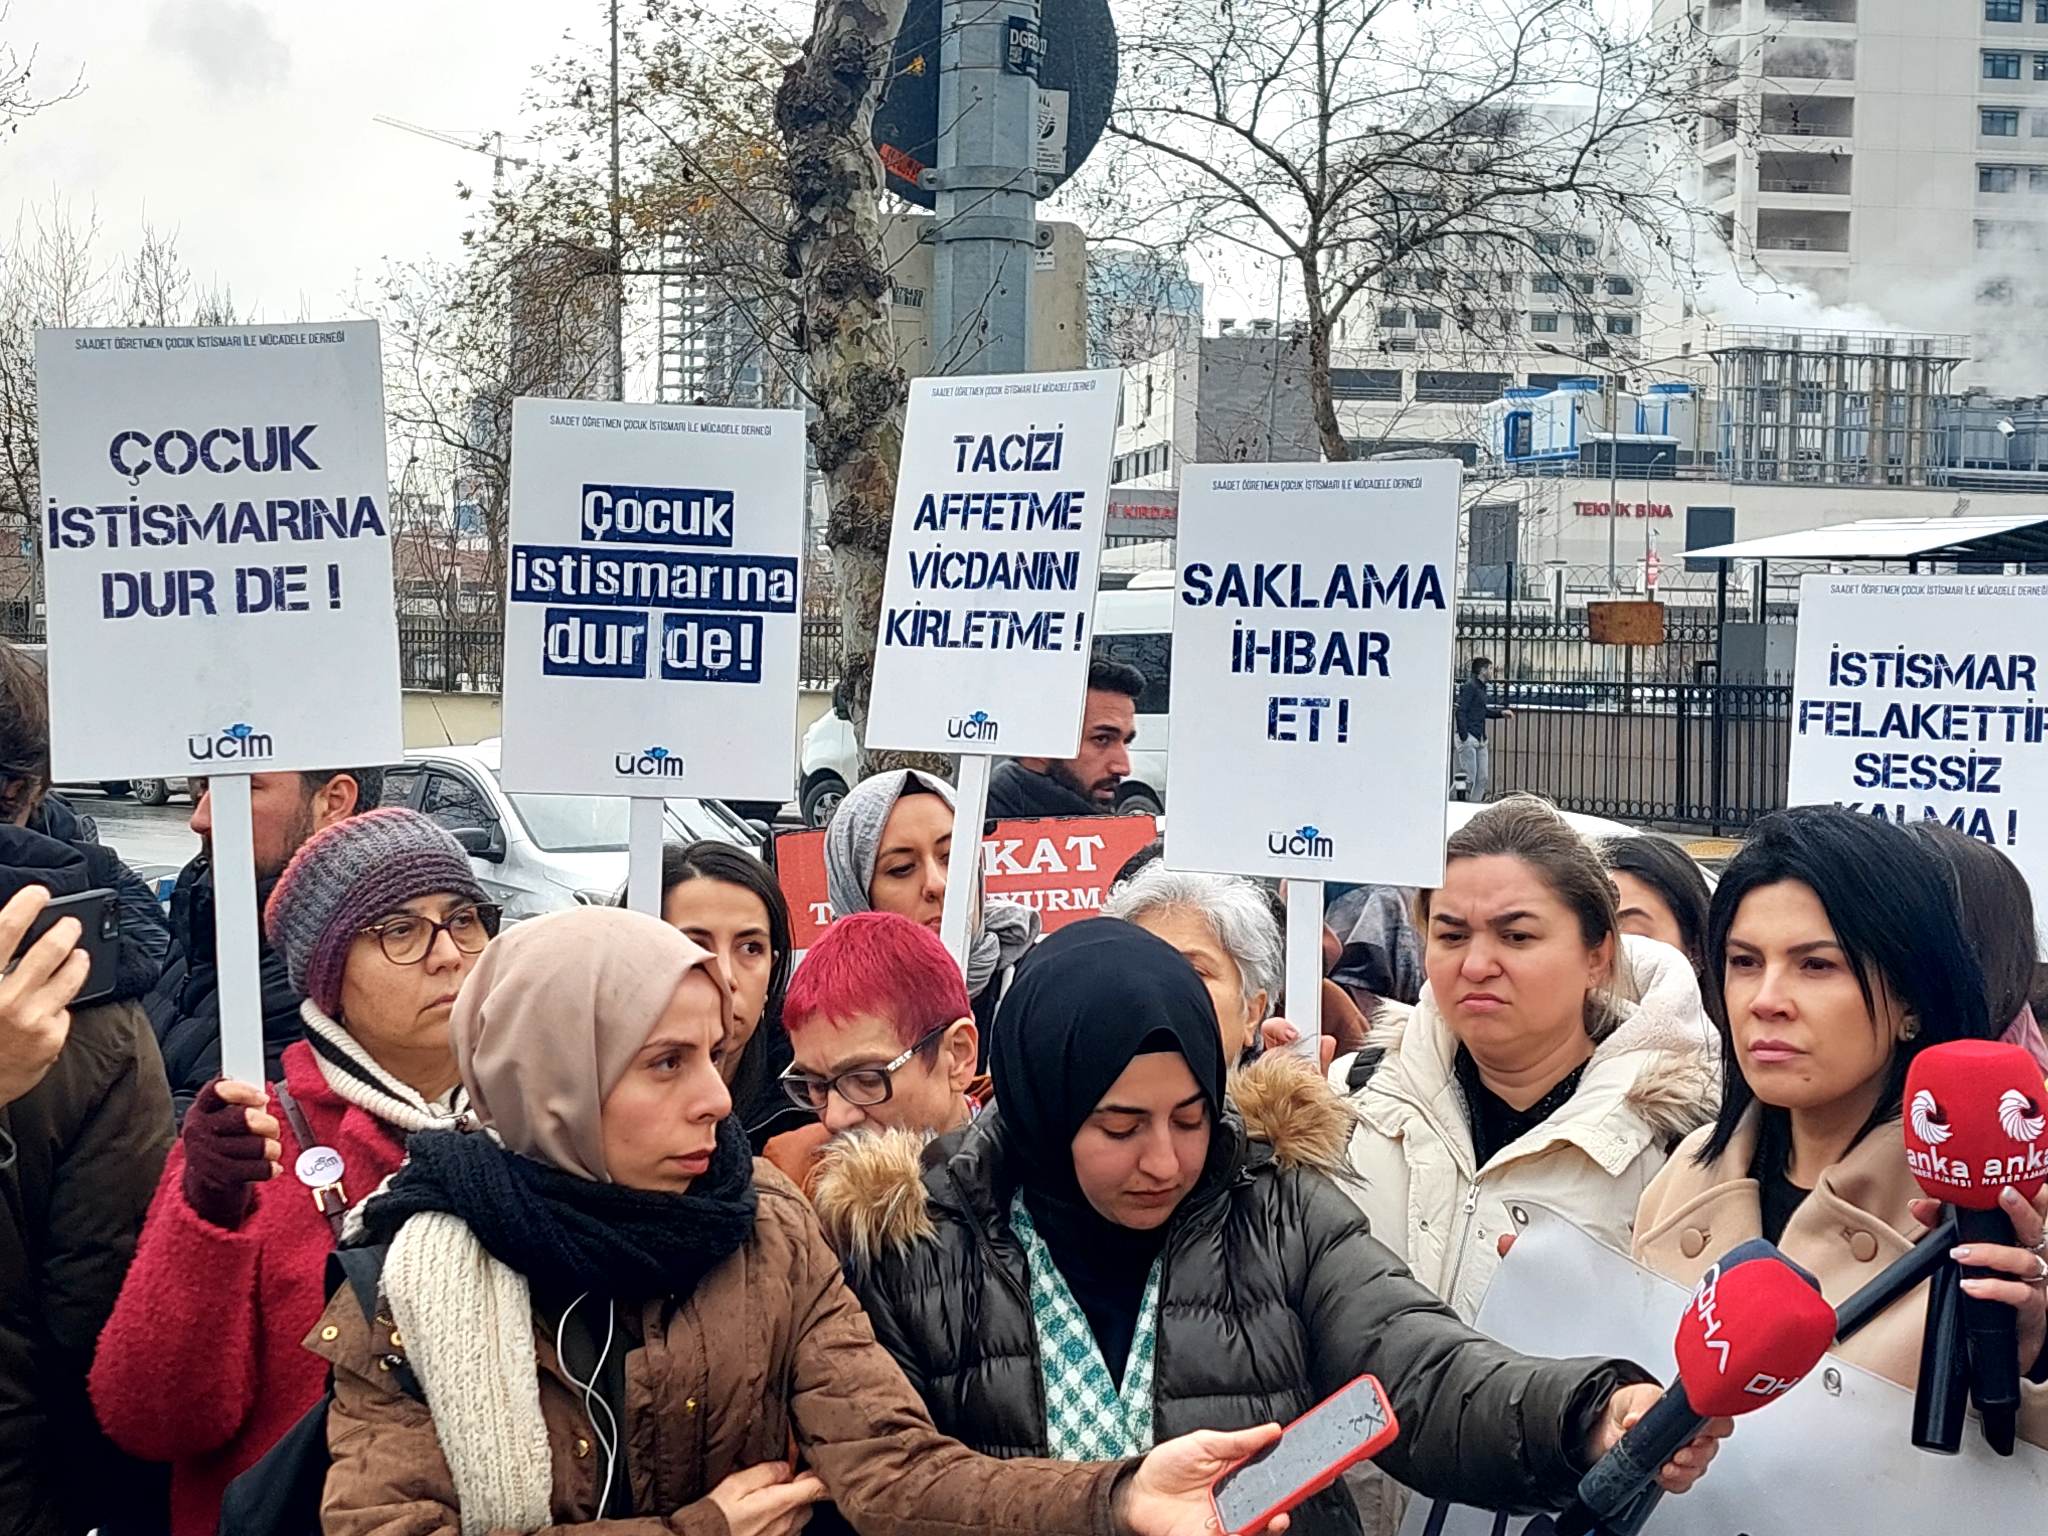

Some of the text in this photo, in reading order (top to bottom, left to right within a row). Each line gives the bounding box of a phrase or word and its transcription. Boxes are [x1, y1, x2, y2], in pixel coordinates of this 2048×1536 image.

[75, 338, 112, 350] SAADET
[114, 337, 163, 350] ÖĞRETMEN
[165, 336, 194, 351] ÇOCUK
[197, 335, 242, 348] İSTİSMARI
[244, 334, 257, 347] İLE
[259, 332, 306, 345] MÜCADELE
[550, 415, 580, 427] SAADET
[582, 416, 622, 429] ÖĞRETMEN
[624, 418, 648, 432] ÇOCUK
[688, 421, 700, 433] İLE
[700, 422, 740, 435] MÜCADELE
[953, 422, 1064, 473] TACİZİ
[109, 425, 322, 486] ÇOCUK
[1212, 480, 1240, 491] SAADET
[1241, 479, 1279, 491] ÖĞRETMEN
[1280, 479, 1304, 492] ÇOCUK
[1353, 478, 1392, 490] MÜCADELE
[47, 495, 386, 549] İSTİSMARINA
[584, 490, 732, 541] Çocuk
[912, 490, 1086, 532] AFFETME
[515, 551, 794, 603] istismarına
[908, 542, 1079, 591] VİCDANINI
[1181, 562, 1447, 610] SAKLAMA
[1830, 584, 2048, 597] SAADET ÖĞRETMEN ÇOCUK İSTİSMARI İLE MÜCADELE DERNEĞ
[101, 563, 342, 619] DUR DE !
[547, 616, 754, 671] dur de!
[884, 600, 1085, 652] KİRLETME !
[1231, 619, 1391, 678] İHBAR
[1829, 643, 2037, 692] İSTİSMAR
[1267, 696, 1350, 744] ET!
[1853, 748, 2002, 793] SESSİZ
[2007, 809, 2017, 845] !
[981, 835, 1105, 876] KAT
[1906, 1146, 1969, 1178] anka
[1744, 1373, 1800, 1395] DH
